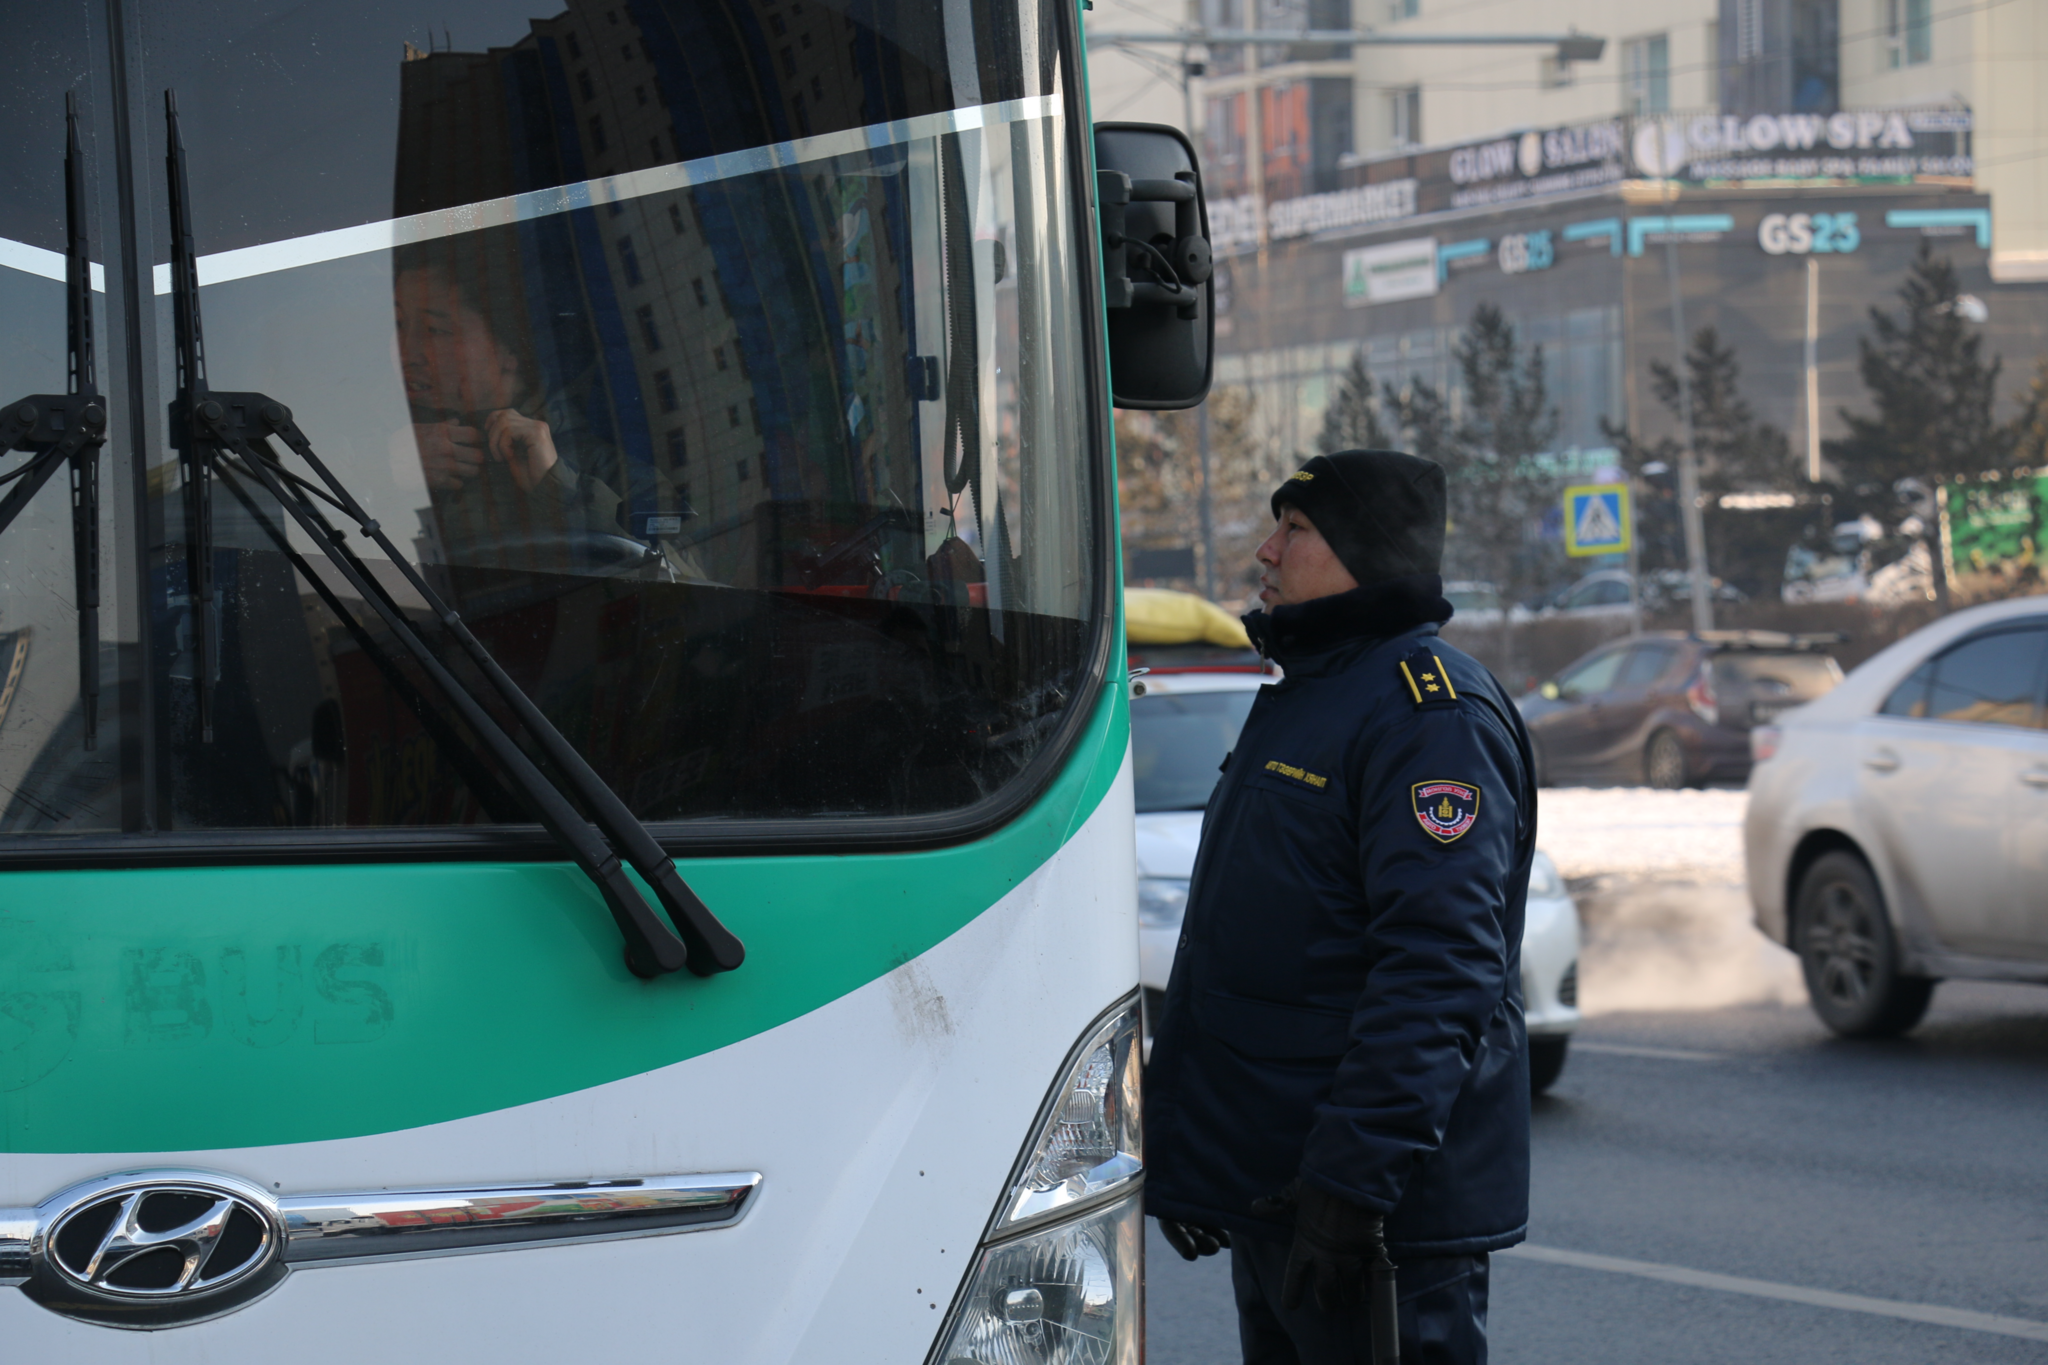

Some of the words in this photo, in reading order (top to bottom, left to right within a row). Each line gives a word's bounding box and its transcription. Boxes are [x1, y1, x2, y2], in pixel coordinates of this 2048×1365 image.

[1449, 140, 1516, 184] GLOW
[1544, 119, 1624, 168] SALON
[1686, 113, 1824, 151] GLOW
[1826, 112, 1914, 149] SPA
[1268, 178, 1419, 241] SUPERMARKET
[1758, 212, 1861, 255] GS25
[1498, 229, 1554, 275] GS25
[122, 942, 395, 1050] BUS
